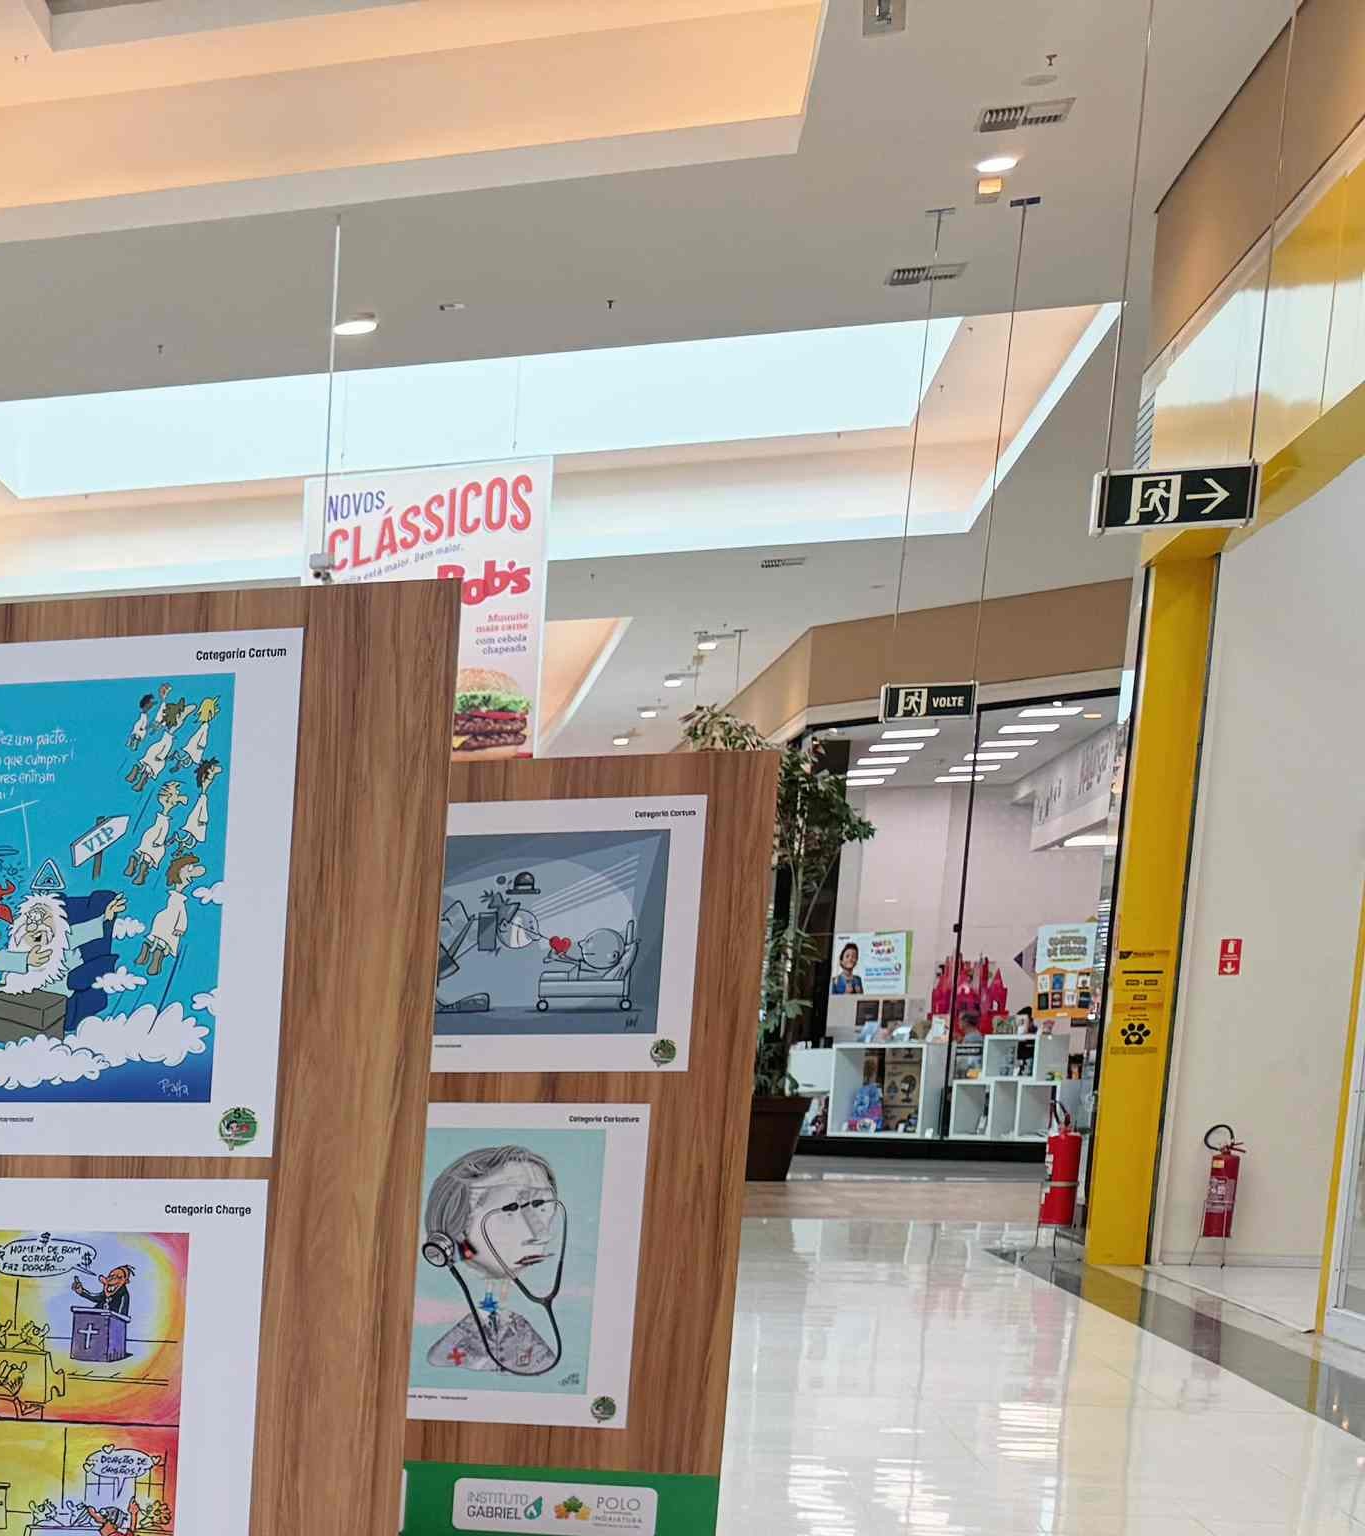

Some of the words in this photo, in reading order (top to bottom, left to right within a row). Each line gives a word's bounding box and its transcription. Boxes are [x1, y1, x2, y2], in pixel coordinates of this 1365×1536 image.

[327, 490, 385, 523] NOVOS
[327, 474, 533, 572] CLÁSSICOS
[497, 635, 527, 644] cebola
[196, 647, 246, 663] Categoria
[248, 647, 287, 658] Cartum
[932, 694, 965, 709] VOLTE
[81, 824, 118, 855] VIP
[164, 1203, 214, 1217] Categoria
[215, 1204, 252, 1217] Charge
[10, 1246, 44, 1254] HOMEM
[467, 1505, 521, 1520] GABRIEL
[596, 1496, 641, 1512] POLO
